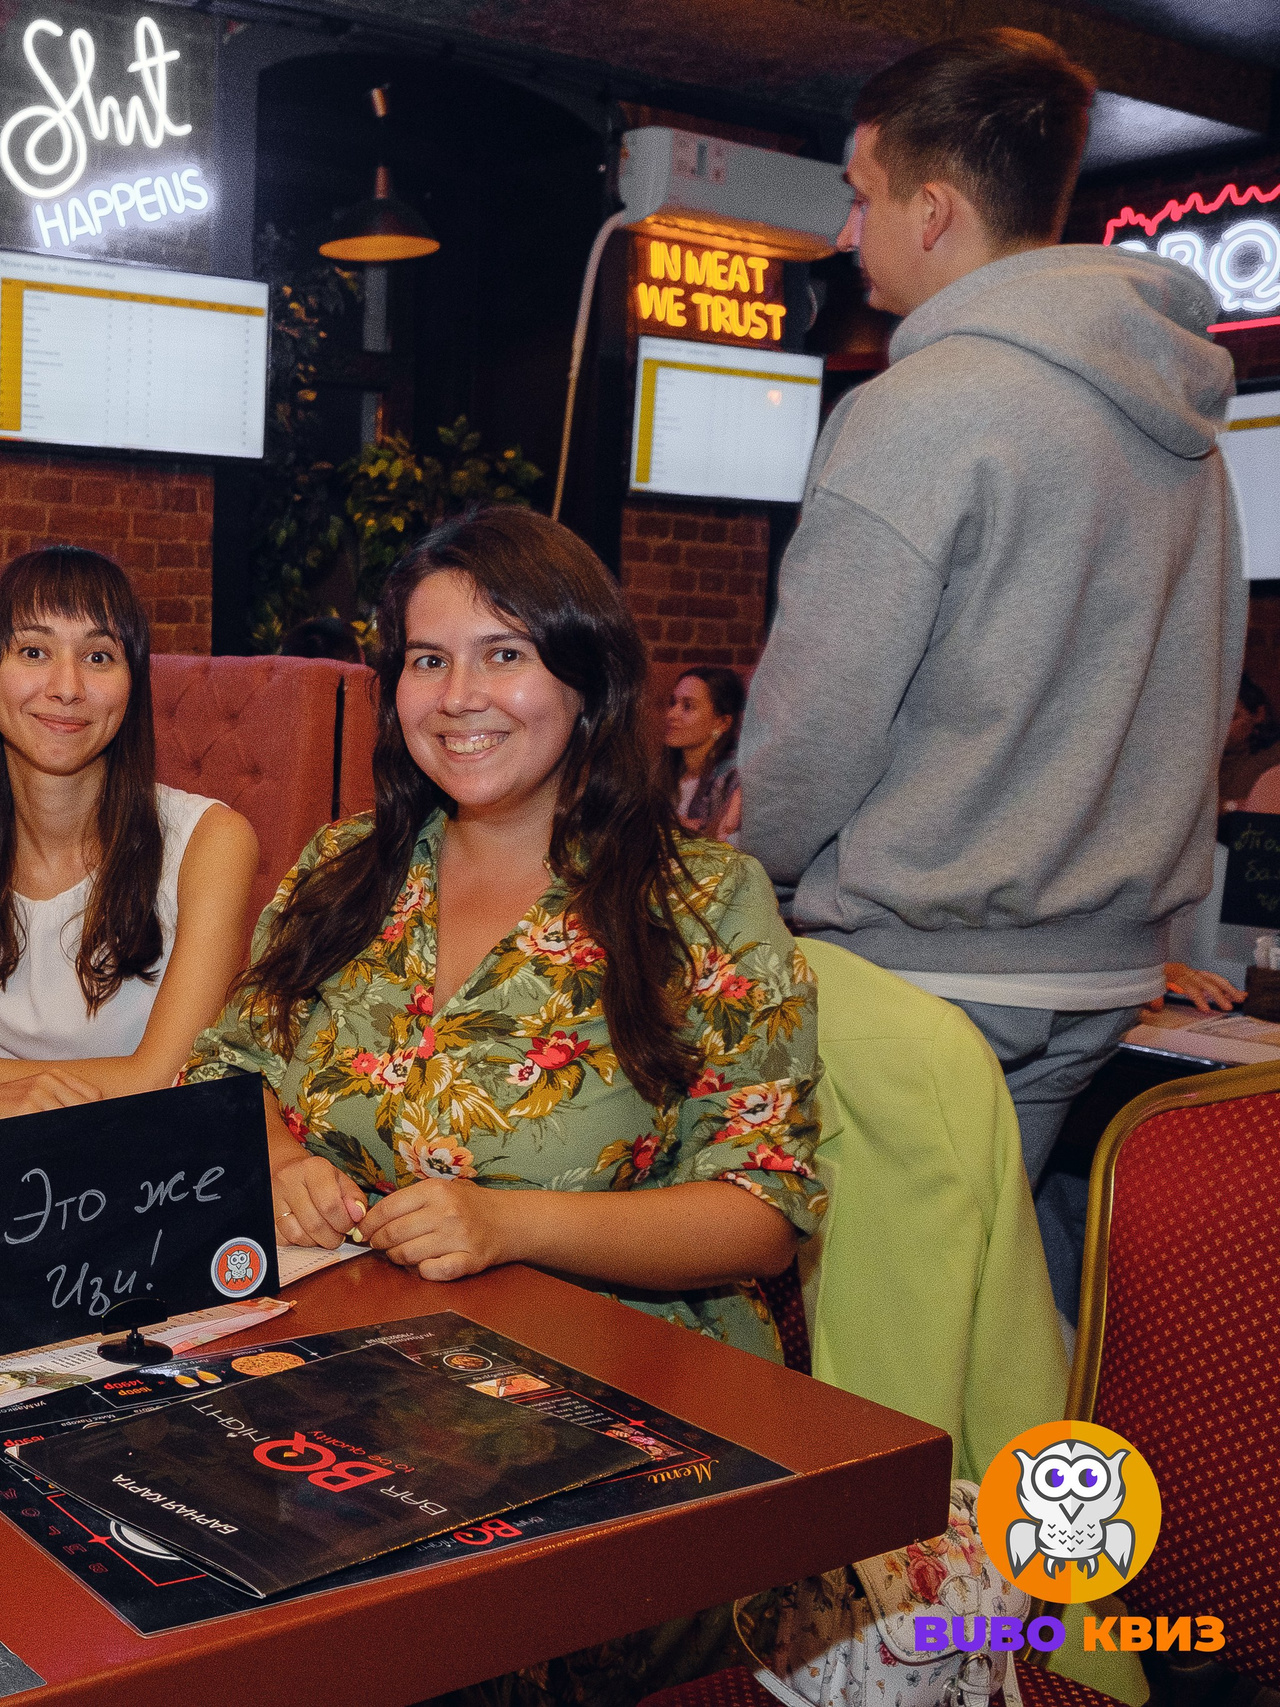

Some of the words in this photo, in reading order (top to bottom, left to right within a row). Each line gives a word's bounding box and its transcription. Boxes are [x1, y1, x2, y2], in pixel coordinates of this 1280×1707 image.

[35, 167, 209, 249] HAPPENS
[650, 241, 681, 281] IN
[685, 249, 769, 294] MEAT
[637, 282, 686, 327] WE
[691, 292, 786, 341] TRUST
[4, 1167, 107, 1245] Это
[134, 1166, 225, 1214] же
[307, 1430, 366, 1456] quality
[253, 1431, 396, 1493] BQ
[368, 1454, 393, 1466] be
[395, 1463, 416, 1474] to
[647, 1459, 720, 1484] Menu
[112, 1474, 168, 1503] КАРТА
[380, 1485, 448, 1516] BAR
[161, 1500, 239, 1535] БАРНАЯ
